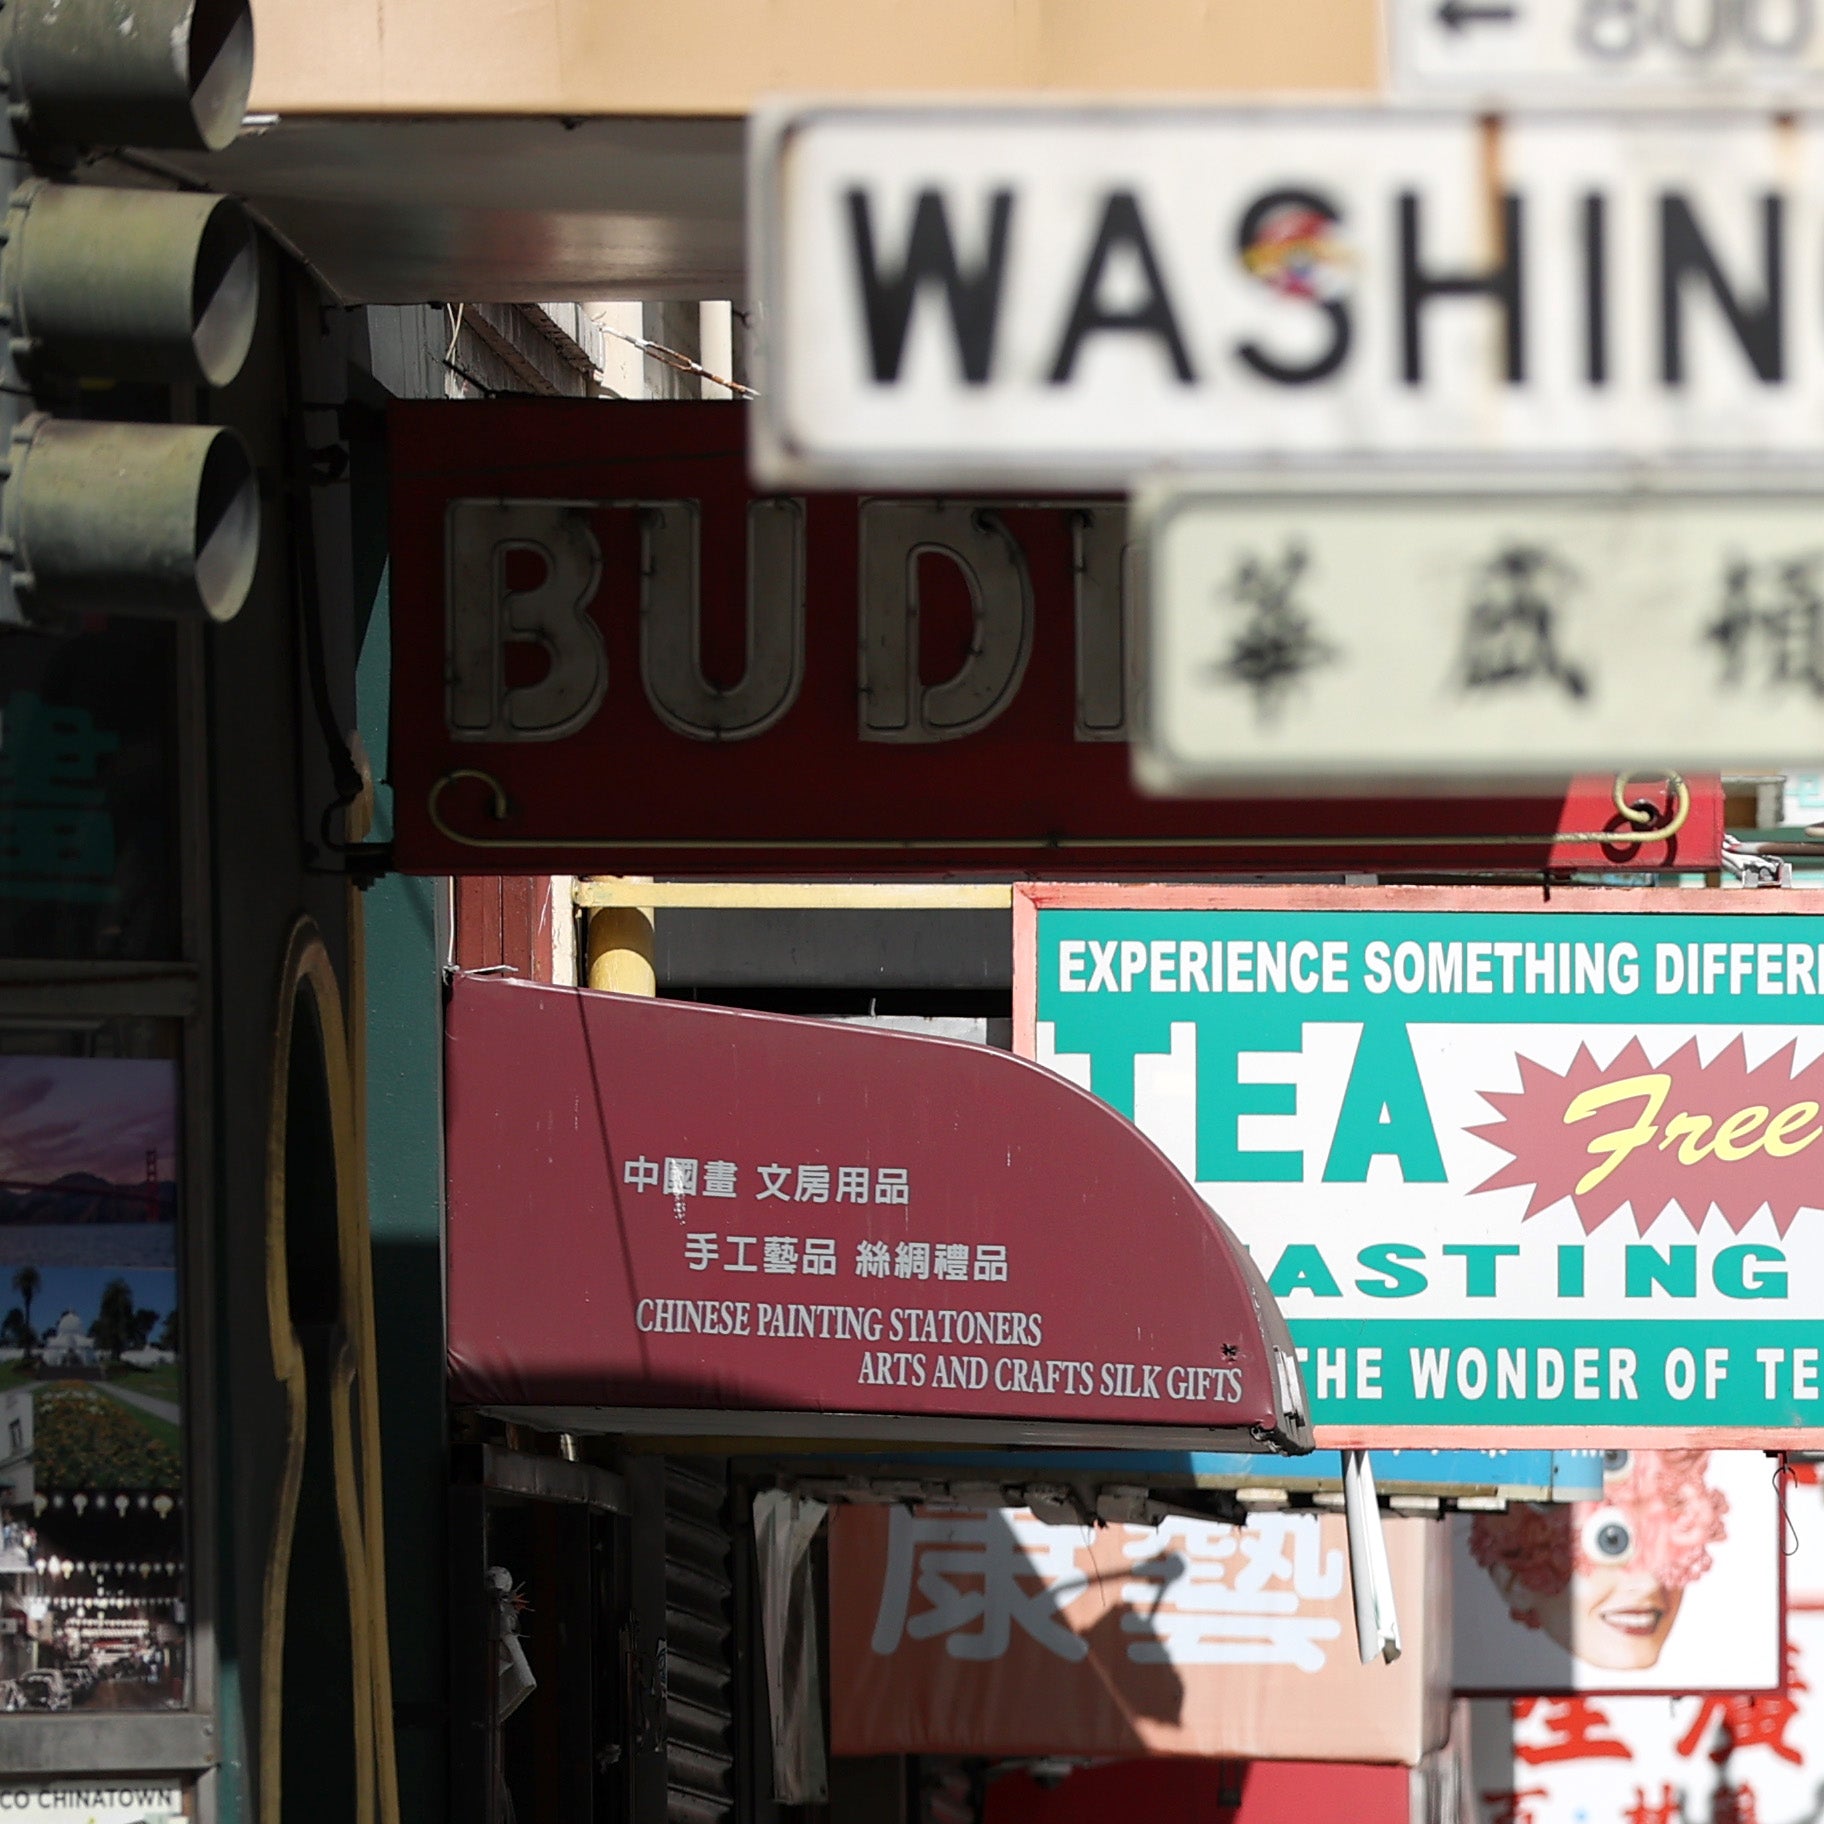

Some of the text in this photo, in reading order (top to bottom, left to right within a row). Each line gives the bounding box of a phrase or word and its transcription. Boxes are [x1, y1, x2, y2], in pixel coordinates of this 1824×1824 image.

[1057, 938, 1350, 996] EXPERIENCE
[1363, 939, 1640, 997] SOMETHING
[1052, 1020, 1449, 1185] TEA
[623, 1154, 910, 1206] 中國畫 文房用品
[1243, 1242, 1790, 1301] ASTING
[635, 1297, 1043, 1349] CHINESE PAINTING STATONERS
[858, 1350, 1244, 1405] ARTS AND CRAFTS SILK GIFTS
[1409, 1346, 1639, 1402] WONDER
[1665, 1347, 1732, 1402] OF
[38, 1788, 173, 1810] CHINATOWN
